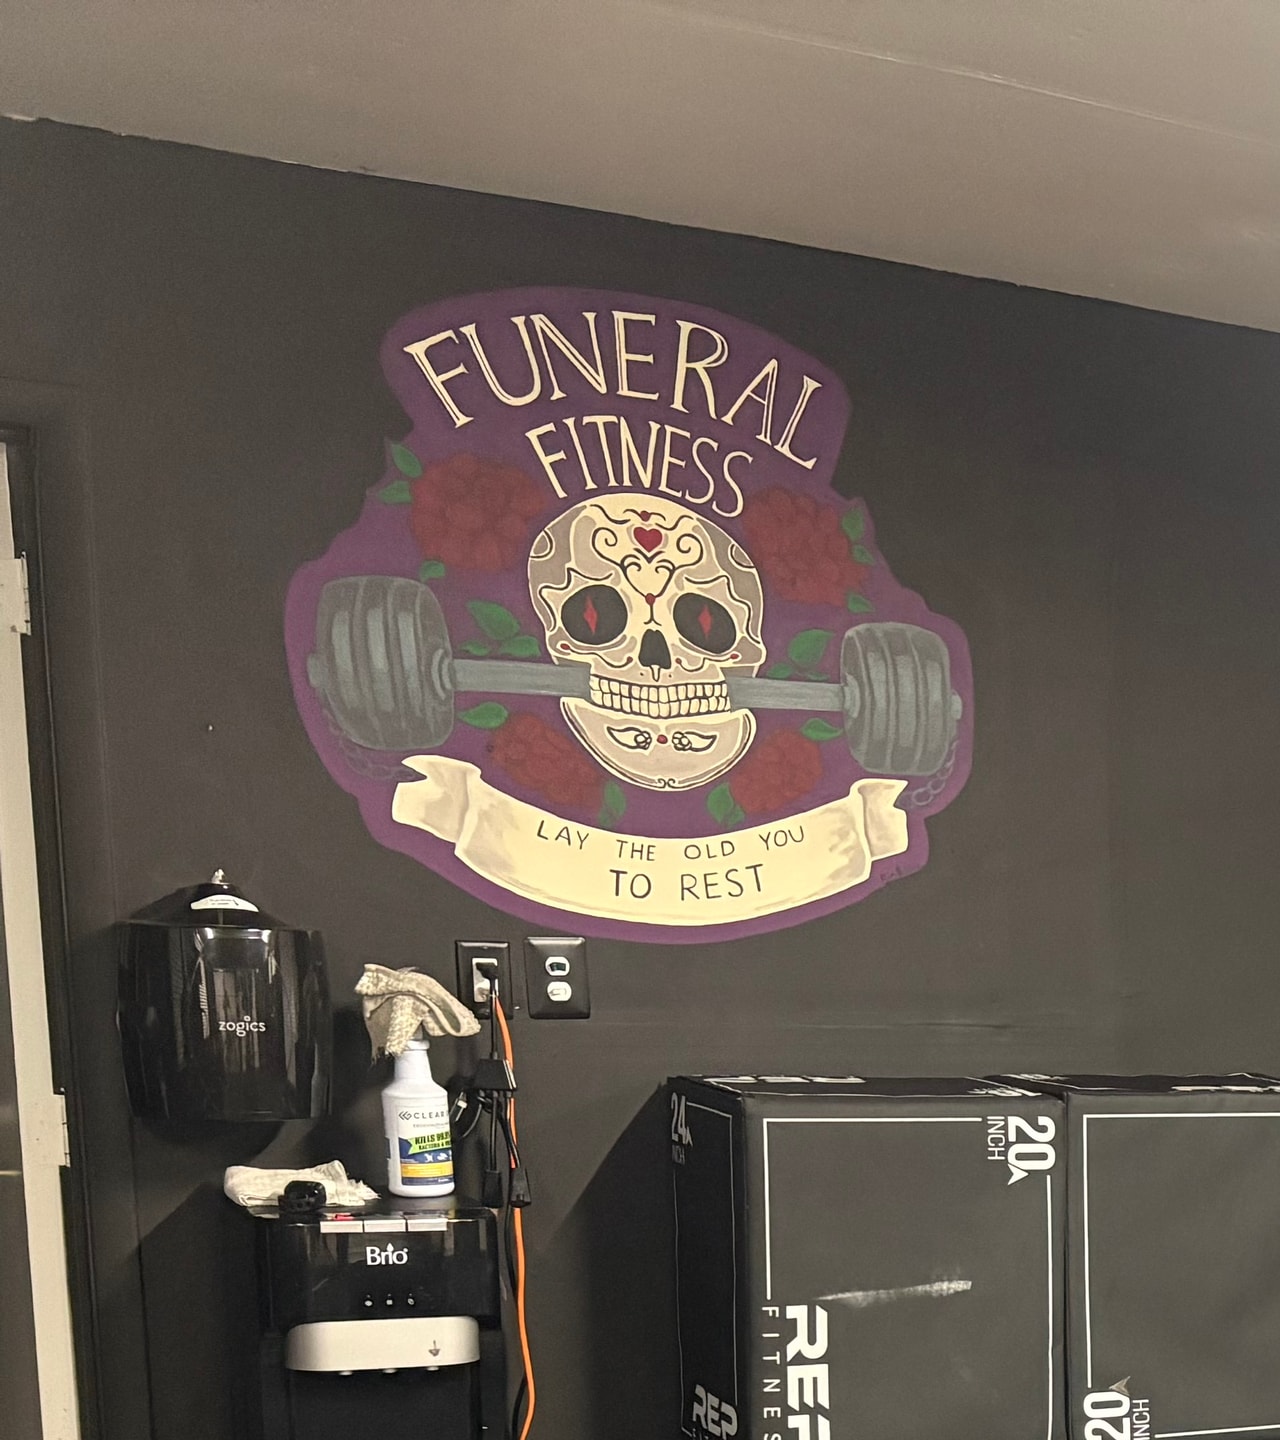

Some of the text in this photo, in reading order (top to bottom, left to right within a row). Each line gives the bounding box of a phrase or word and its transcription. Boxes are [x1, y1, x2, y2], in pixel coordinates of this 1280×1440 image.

[403, 309, 822, 470] FUNERAL
[525, 415, 754, 518] FITNESS
[536, 820, 805, 863] LAY THE OLD YOU
[609, 864, 764, 901] TO REST
[218, 1015, 266, 1037] zogics
[413, 1111, 445, 1120] CLEAR
[671, 1093, 687, 1142] 24
[414, 1133, 436, 1145] KILLS
[986, 1115, 1006, 1161] INCH
[1008, 1115, 1056, 1171] 20
[366, 1243, 408, 1266] Brio
[693, 1384, 738, 1440] REP
[1132, 1399, 1150, 1440] INCH
